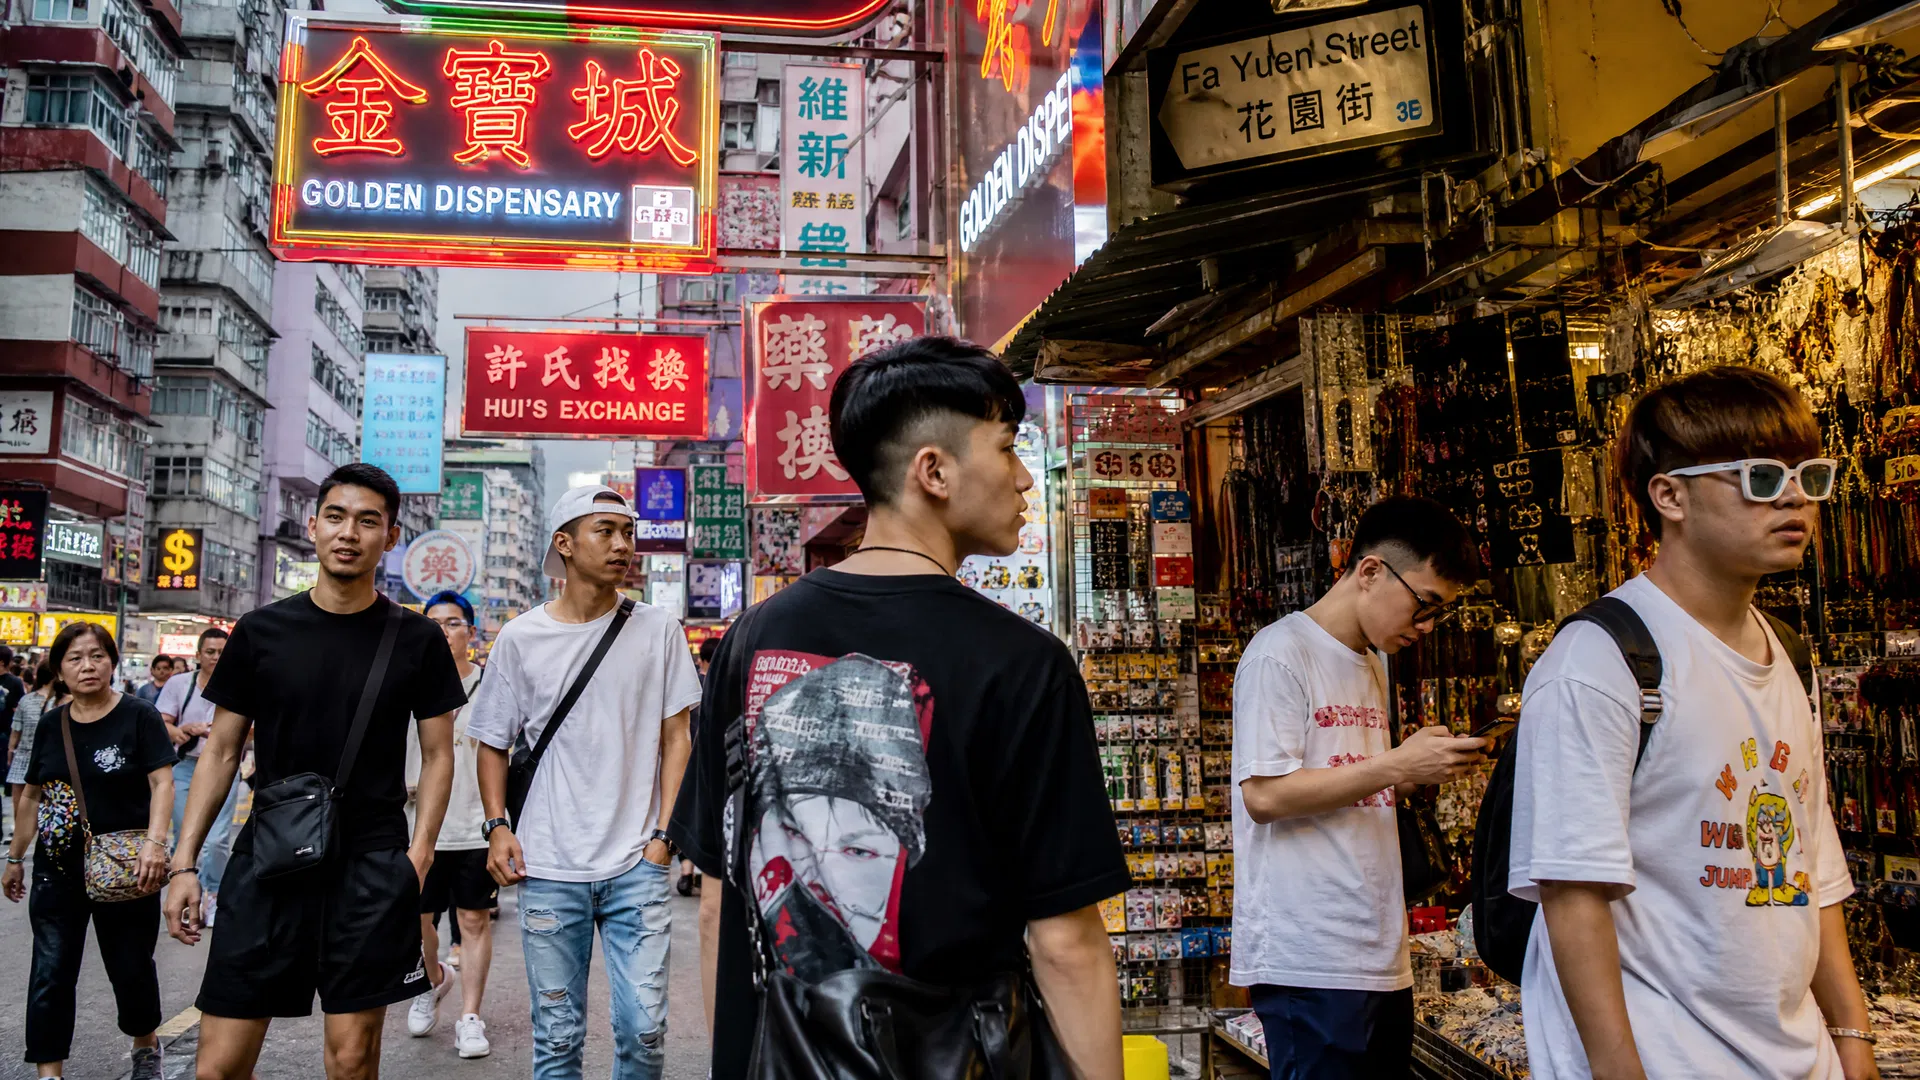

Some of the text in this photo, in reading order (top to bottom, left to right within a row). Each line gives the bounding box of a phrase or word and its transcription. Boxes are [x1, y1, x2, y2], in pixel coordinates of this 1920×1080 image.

[1182, 20, 1421, 94] Fa Yuen Street
[301, 35, 699, 168] 金寶城
[1237, 82, 1373, 143] 花園街
[302, 179, 422, 211] GOLDEN
[435, 184, 621, 219] DISPENSARY
[960, 143, 1013, 253] GOLDEN
[484, 344, 690, 391] 許氏找換
[484, 398, 685, 422] HUI'S EXCHANGE
